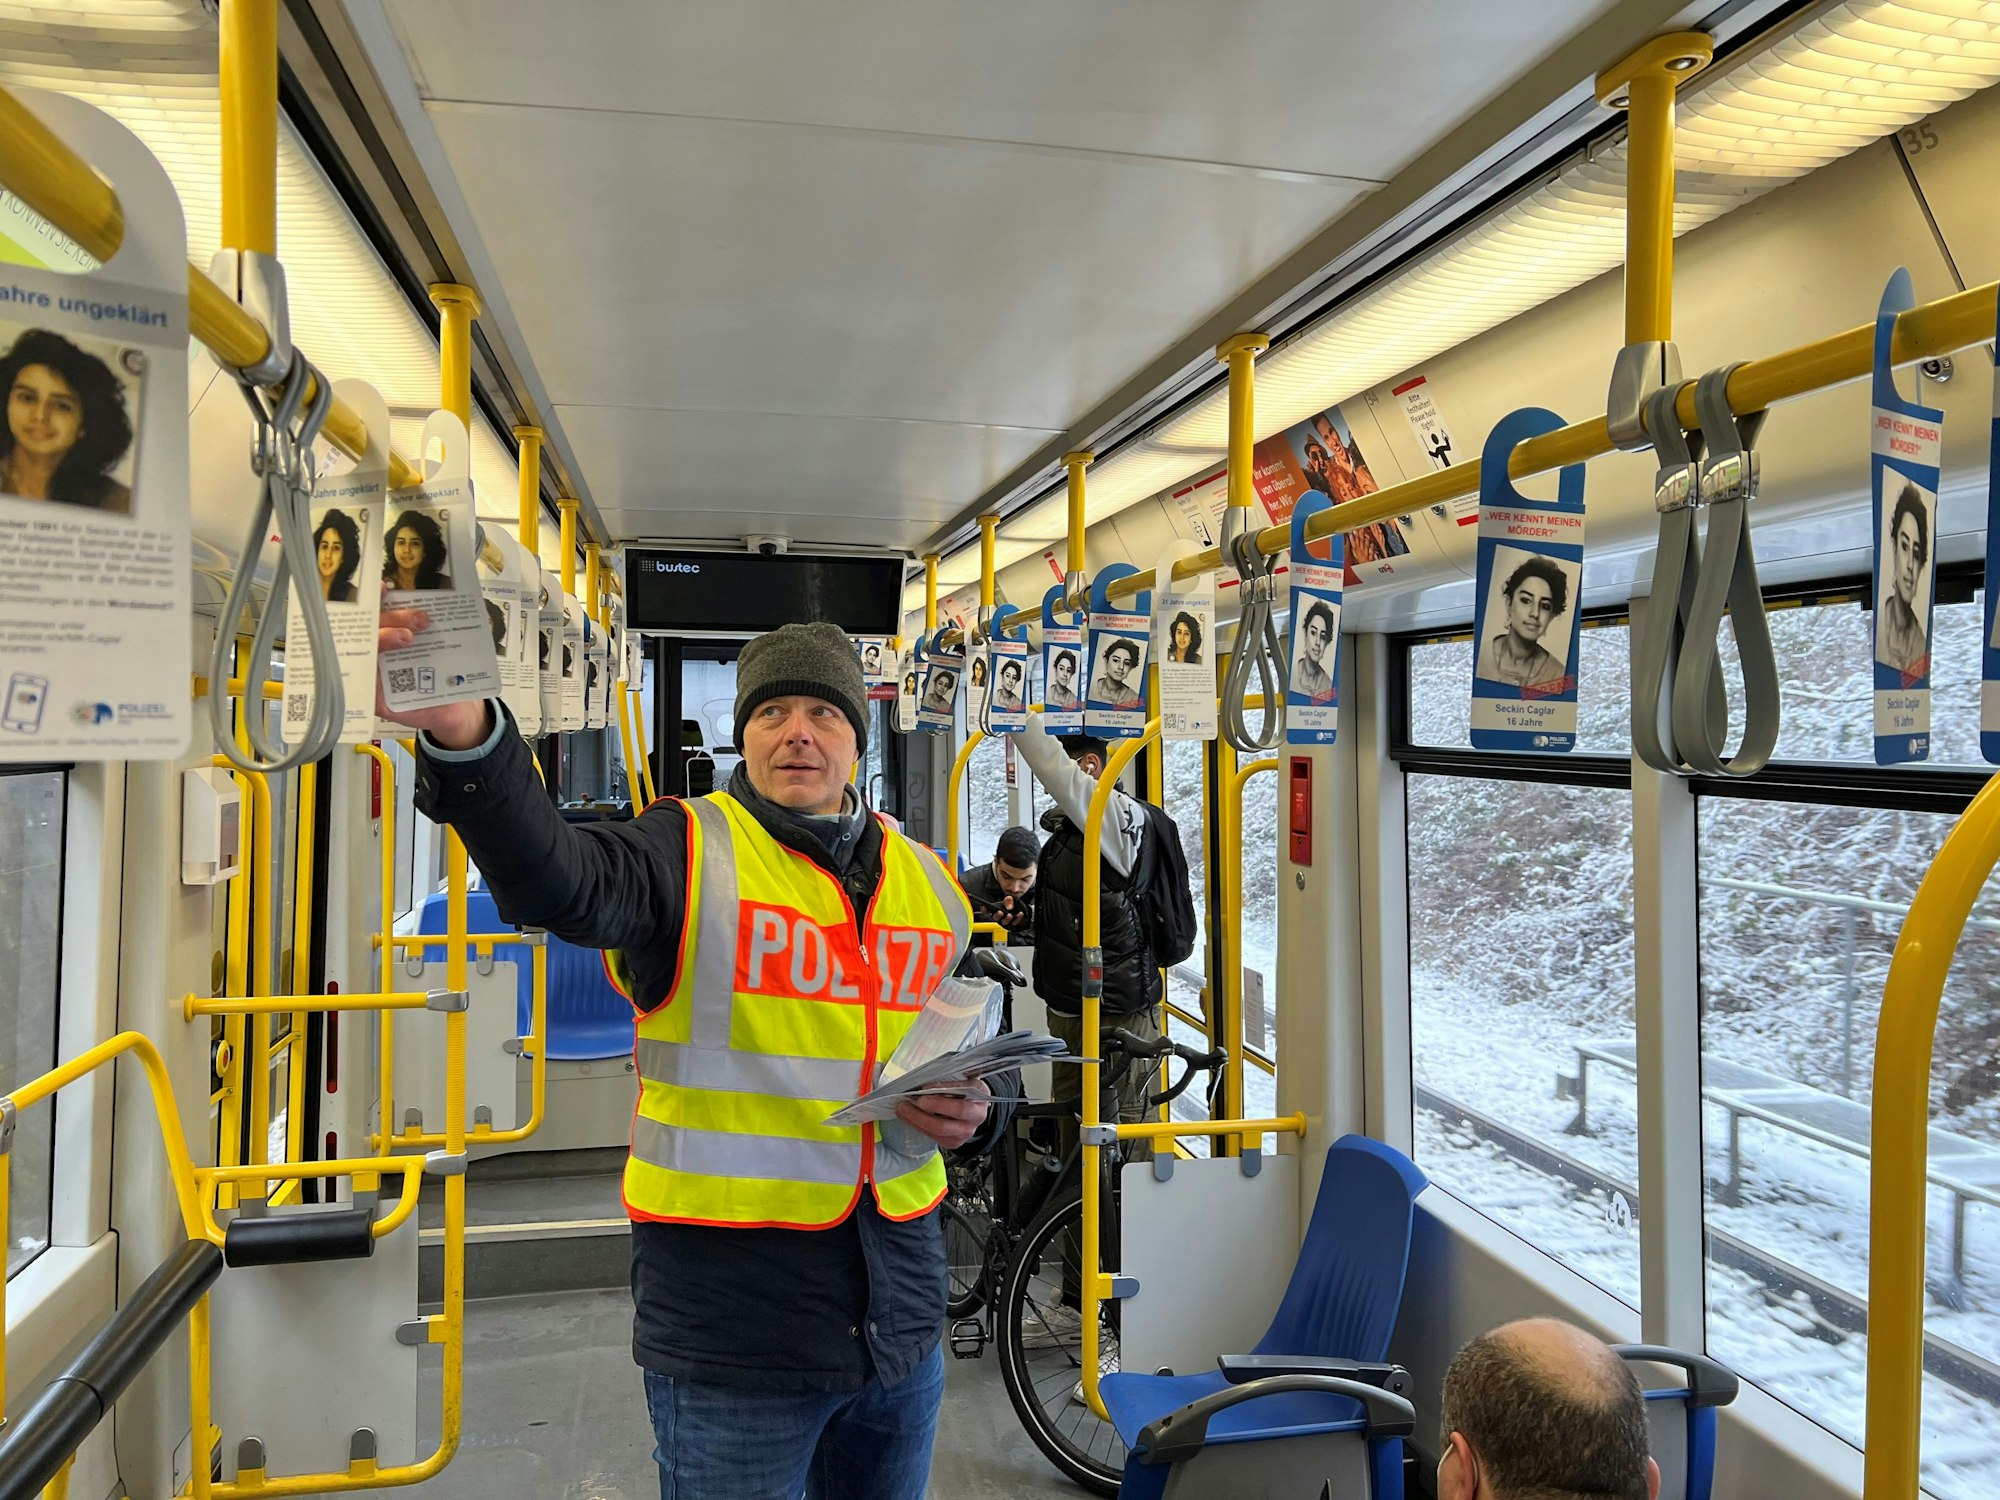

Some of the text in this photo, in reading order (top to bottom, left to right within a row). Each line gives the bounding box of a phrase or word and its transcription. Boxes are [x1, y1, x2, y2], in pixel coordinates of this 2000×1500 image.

[1902, 122, 1939, 155] 35
[0, 285, 168, 328] ahre ungeklärt
[314, 483, 380, 499] Jahre ungeklärt
[1261, 473, 1296, 496] von überall
[416, 488, 460, 501] ungeklärt
[1513, 513, 1545, 524] KENNT
[1547, 516, 1582, 527] MEINEN
[656, 560, 700, 573] bustec
[1185, 599, 1210, 607] ungeklärt
[1495, 703, 1556, 716] Seckin Caglar
[1506, 717, 1543, 727] 16 Jahre
